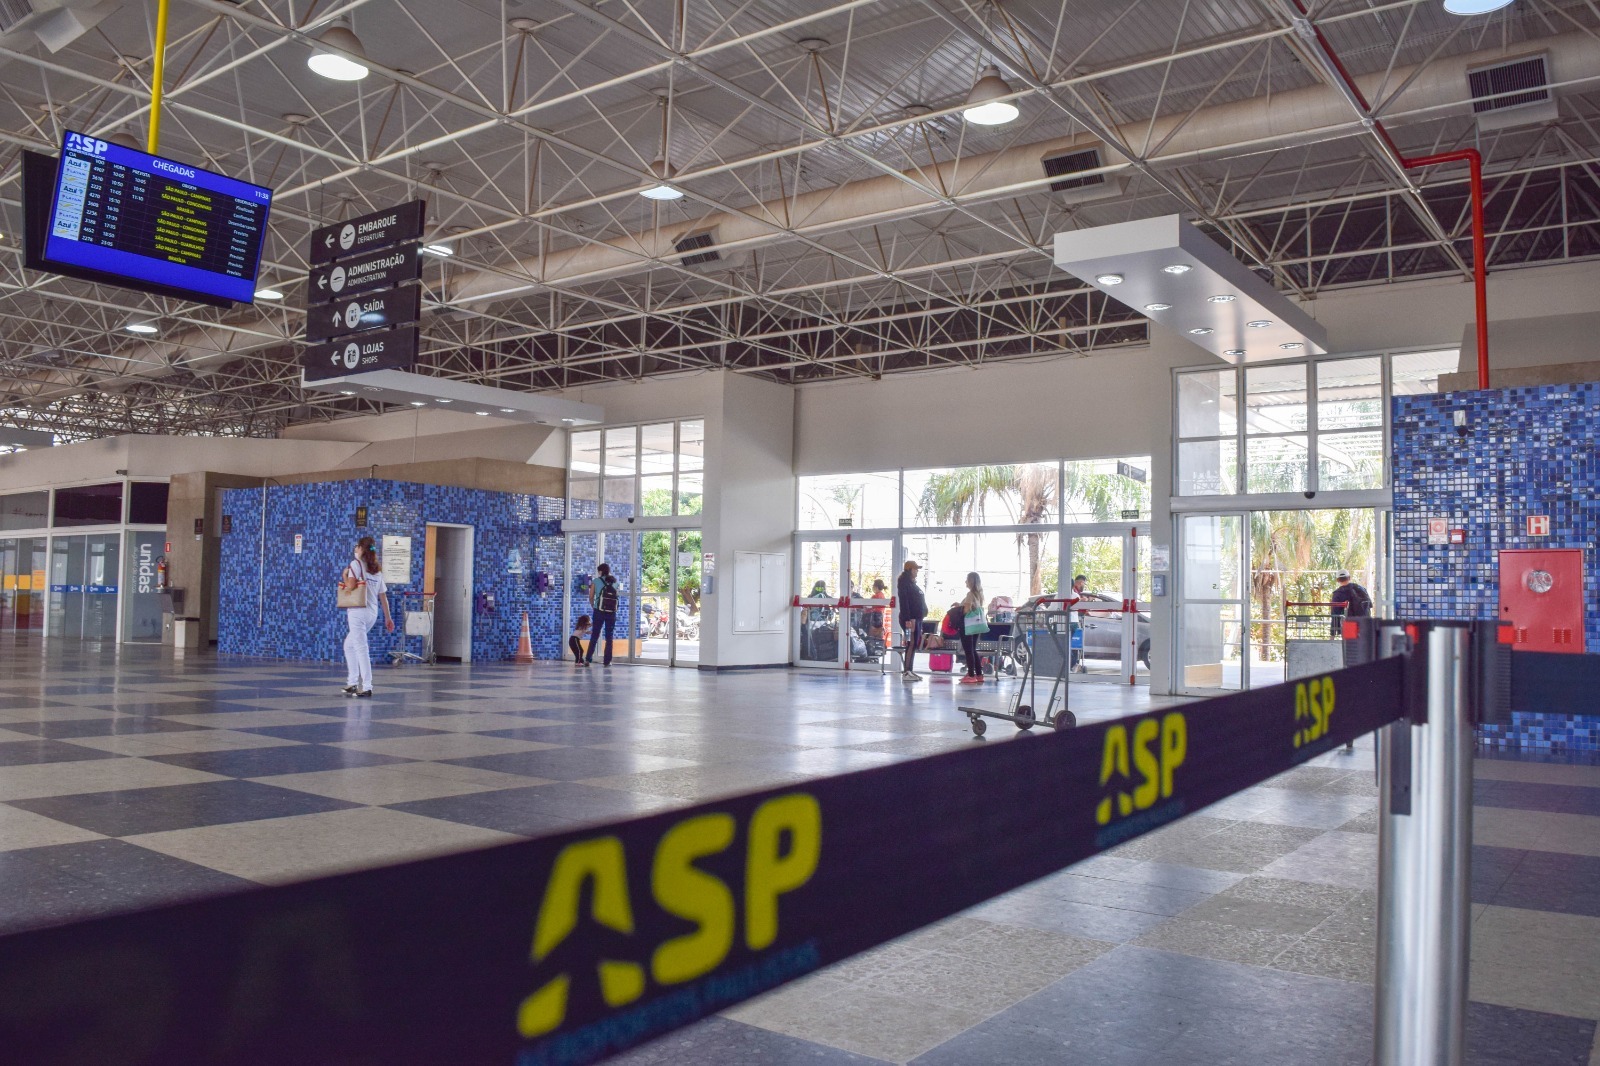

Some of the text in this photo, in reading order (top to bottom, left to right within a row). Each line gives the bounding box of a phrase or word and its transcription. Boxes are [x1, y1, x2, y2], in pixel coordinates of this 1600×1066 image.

[67, 133, 108, 154] ASP
[153, 160, 195, 178] CHEGADAS
[256, 191, 268, 199] 11:38
[358, 214, 396, 234] EMBARQUE
[358, 231, 385, 244] DEPARTURE
[348, 253, 404, 277] ADMINISTRAÇÃO
[347, 272, 386, 287] ADMINISTRATION
[364, 299, 384, 312] SAÍDA
[362, 342, 384, 355] LOJAS
[362, 356, 378, 364] SHOPS
[1531, 518, 1544, 534] H
[139, 544, 154, 593] unidas
[1293, 676, 1336, 748] ASP
[1096, 712, 1188, 826] ASP
[516, 792, 822, 1038] ASP
